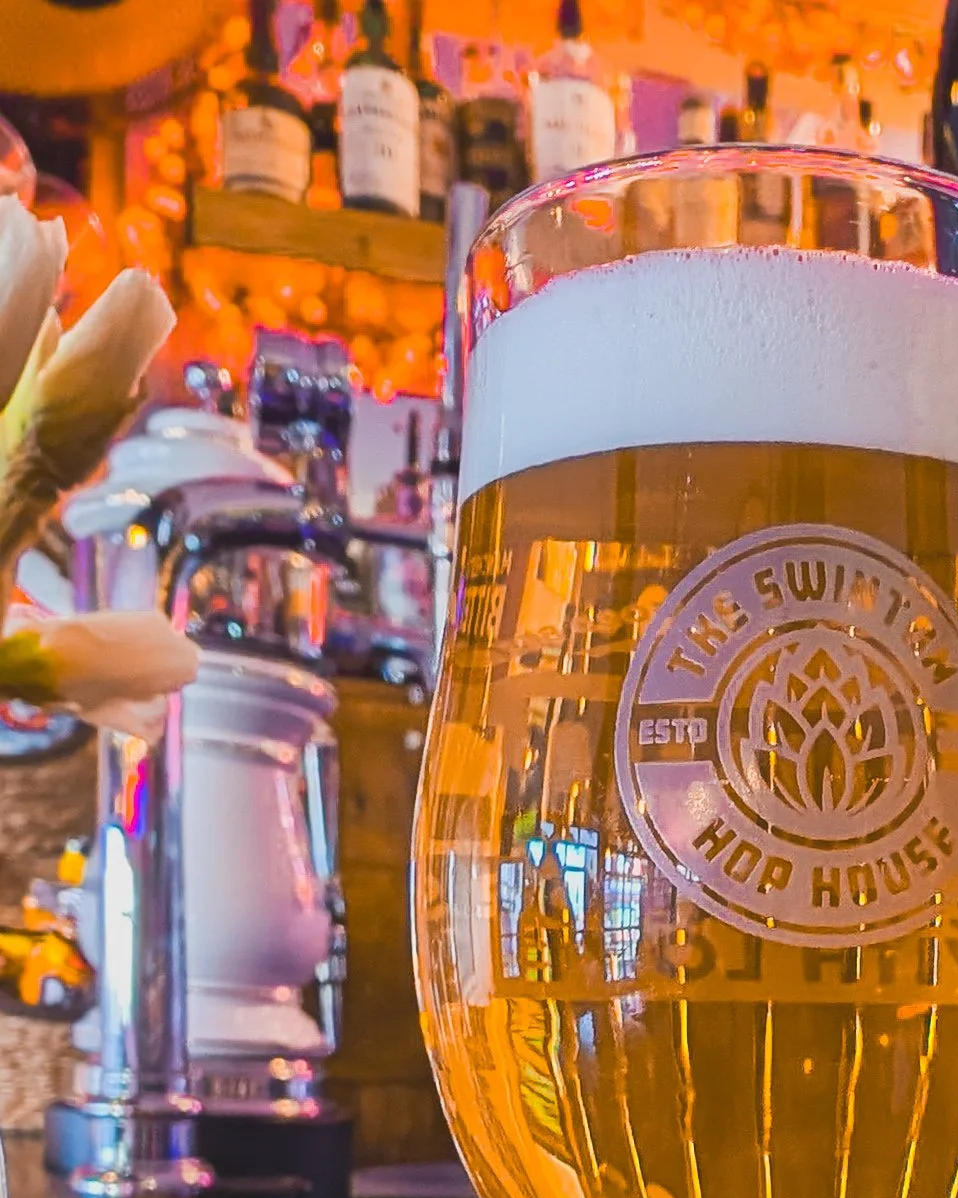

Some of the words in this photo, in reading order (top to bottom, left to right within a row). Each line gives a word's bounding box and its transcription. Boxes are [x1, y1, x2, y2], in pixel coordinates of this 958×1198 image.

[666, 590, 749, 677] THE
[692, 817, 793, 894] HOP
[811, 815, 954, 908] HOUSE
